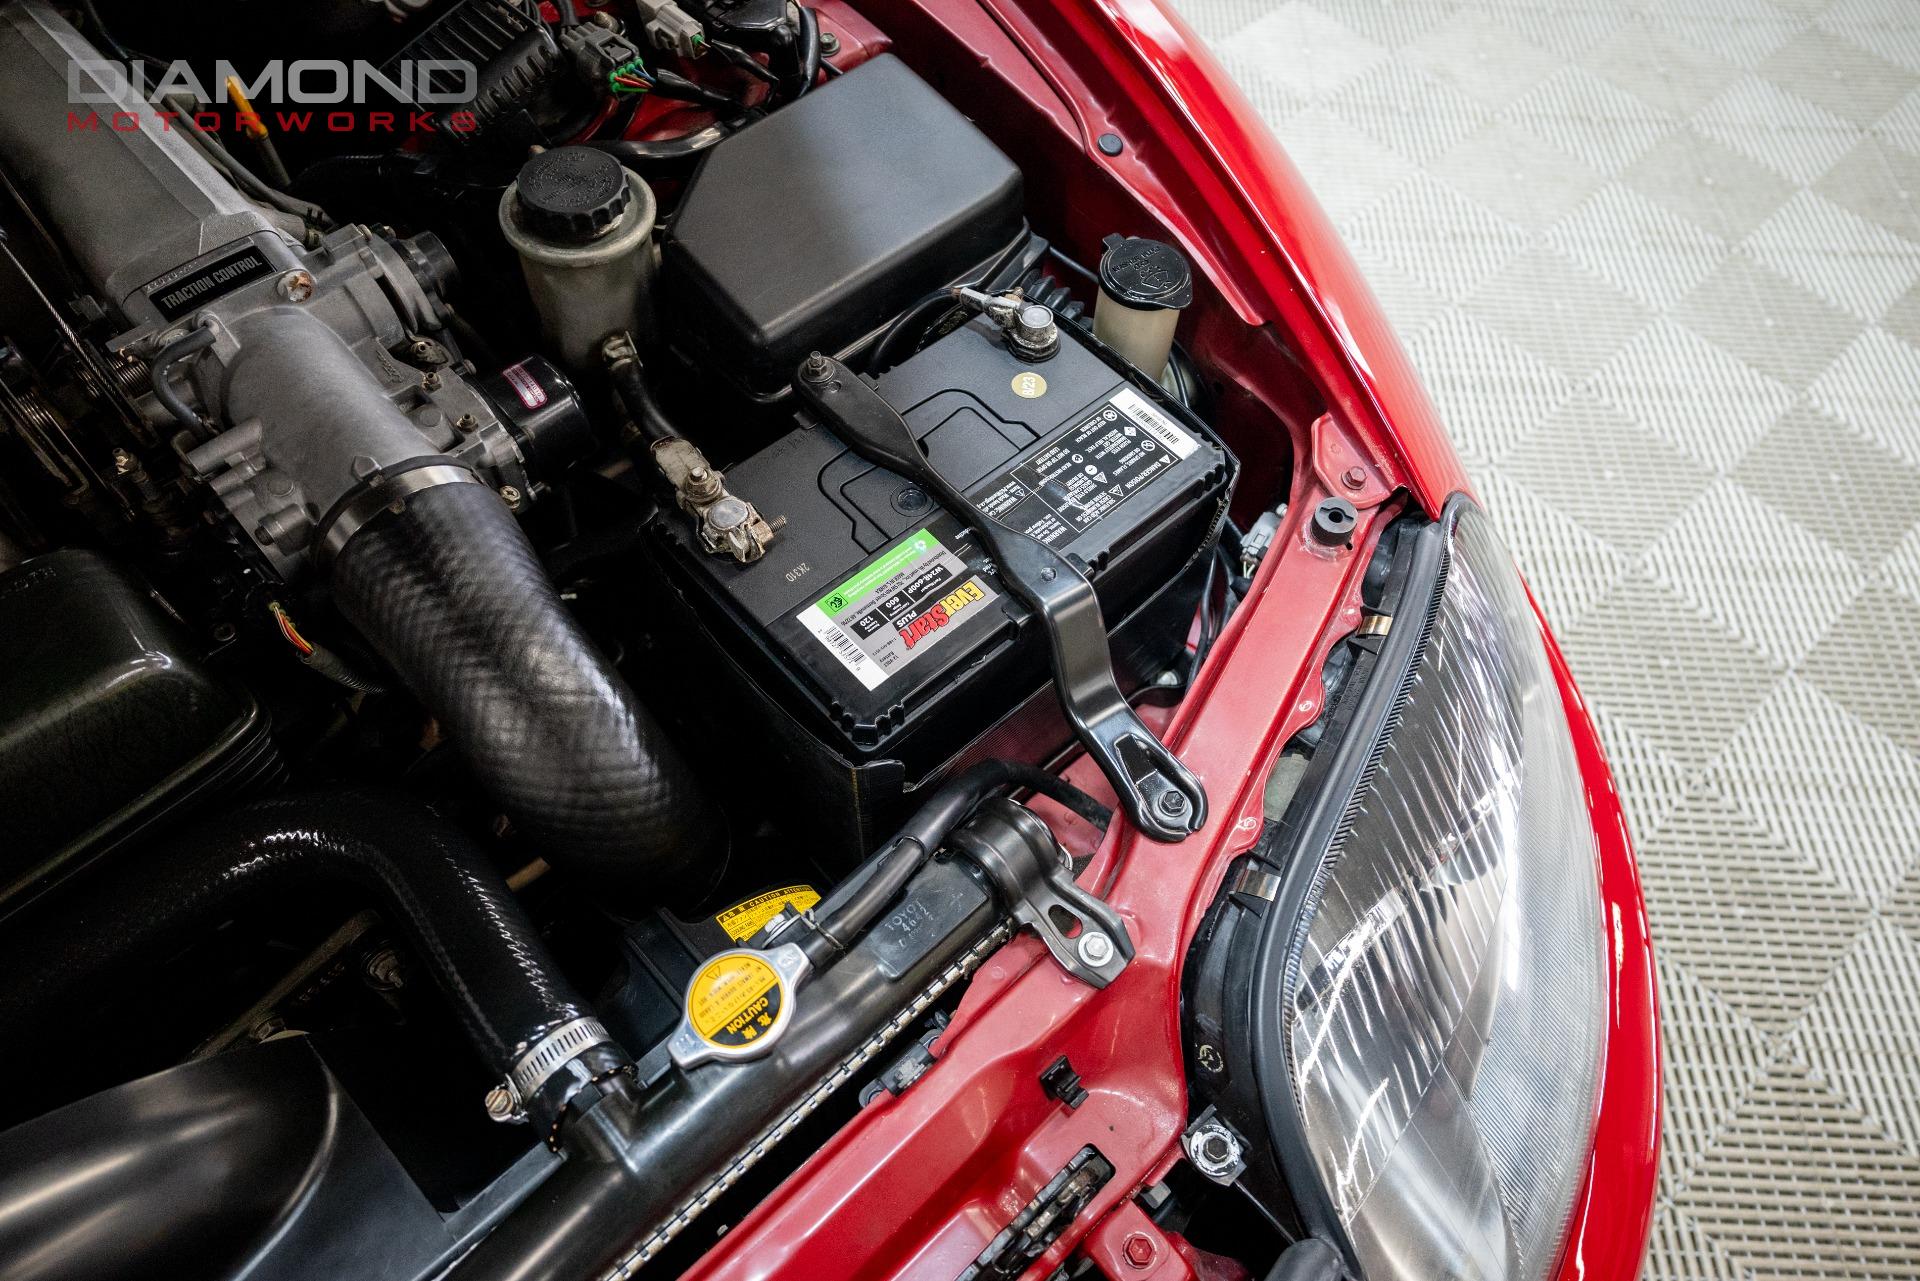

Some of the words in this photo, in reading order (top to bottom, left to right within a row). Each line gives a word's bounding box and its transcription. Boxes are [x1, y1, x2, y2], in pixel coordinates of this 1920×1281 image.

[161, 276, 215, 309] TRACTION
[213, 256, 262, 283] CONTROL
[907, 566, 944, 594] W24R-600P
[885, 596, 900, 609] 600
[860, 615, 874, 627] 120
[897, 610, 917, 628] PLUS
[899, 580, 985, 650] EverStart
[750, 892, 780, 907] CAUTION
[726, 997, 768, 1034] CAUTION
